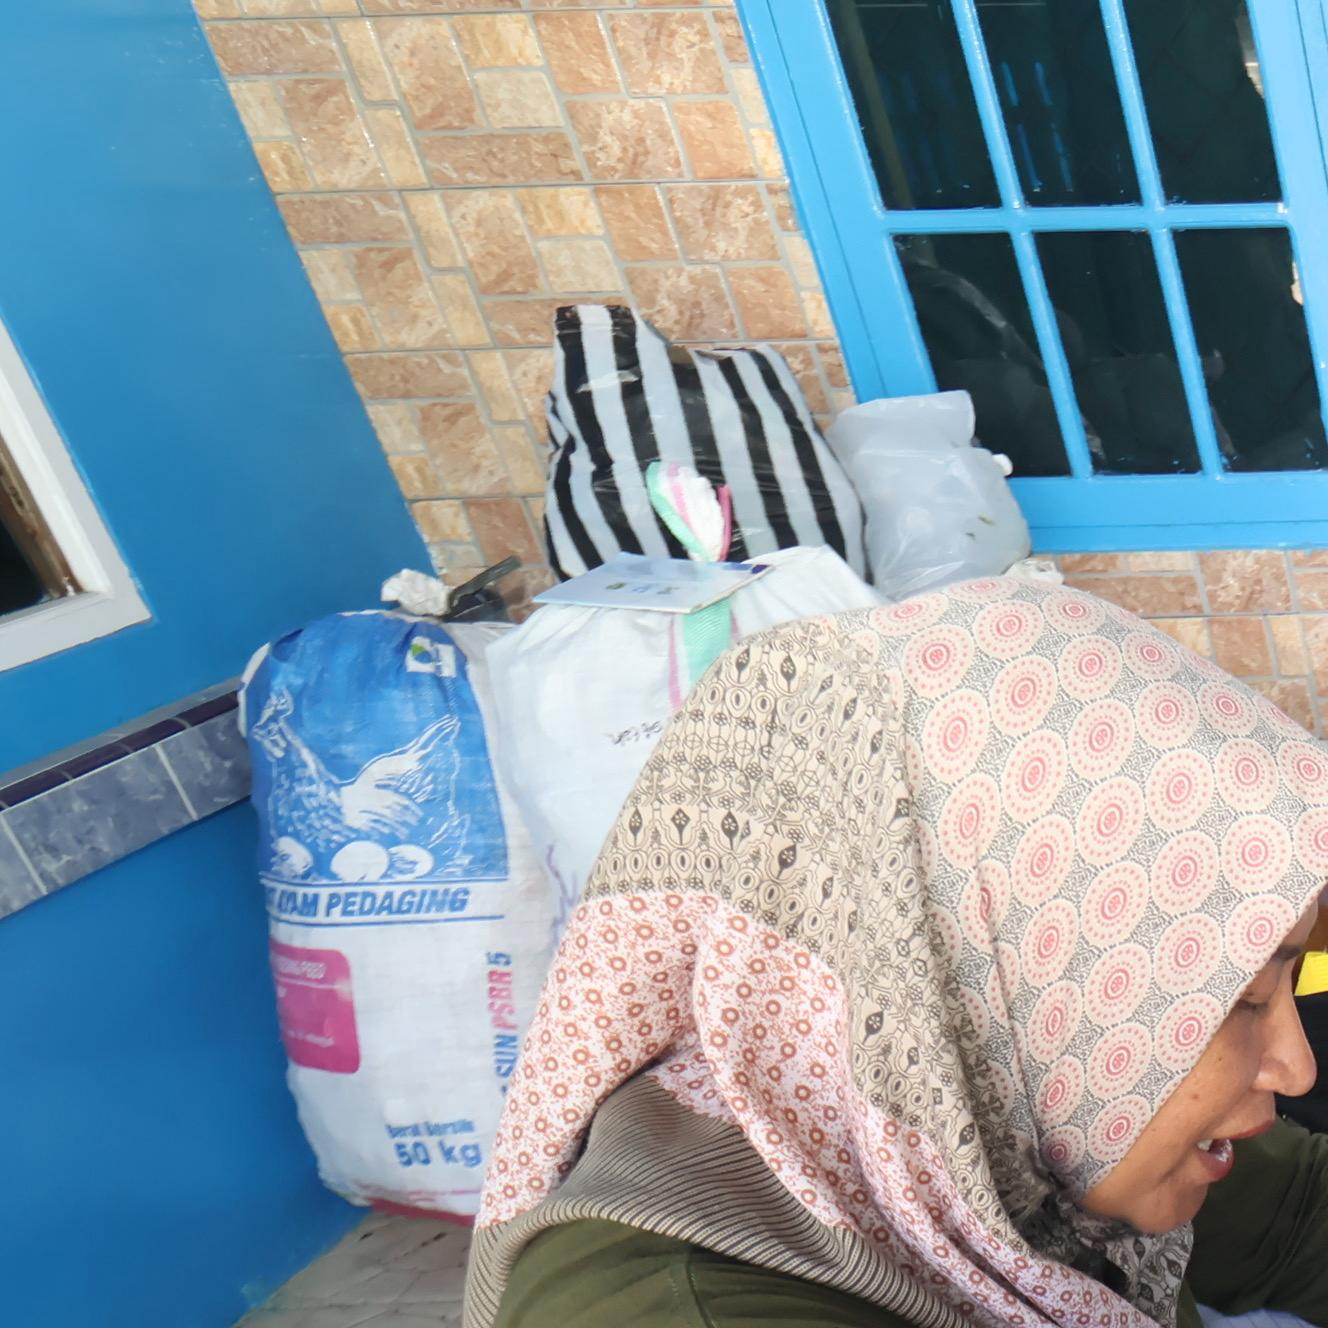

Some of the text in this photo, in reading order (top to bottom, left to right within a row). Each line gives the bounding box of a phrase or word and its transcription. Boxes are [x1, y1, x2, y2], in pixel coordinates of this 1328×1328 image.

[325, 887, 471, 917] PEDAGING
[395, 1140, 482, 1168] 50 kg
